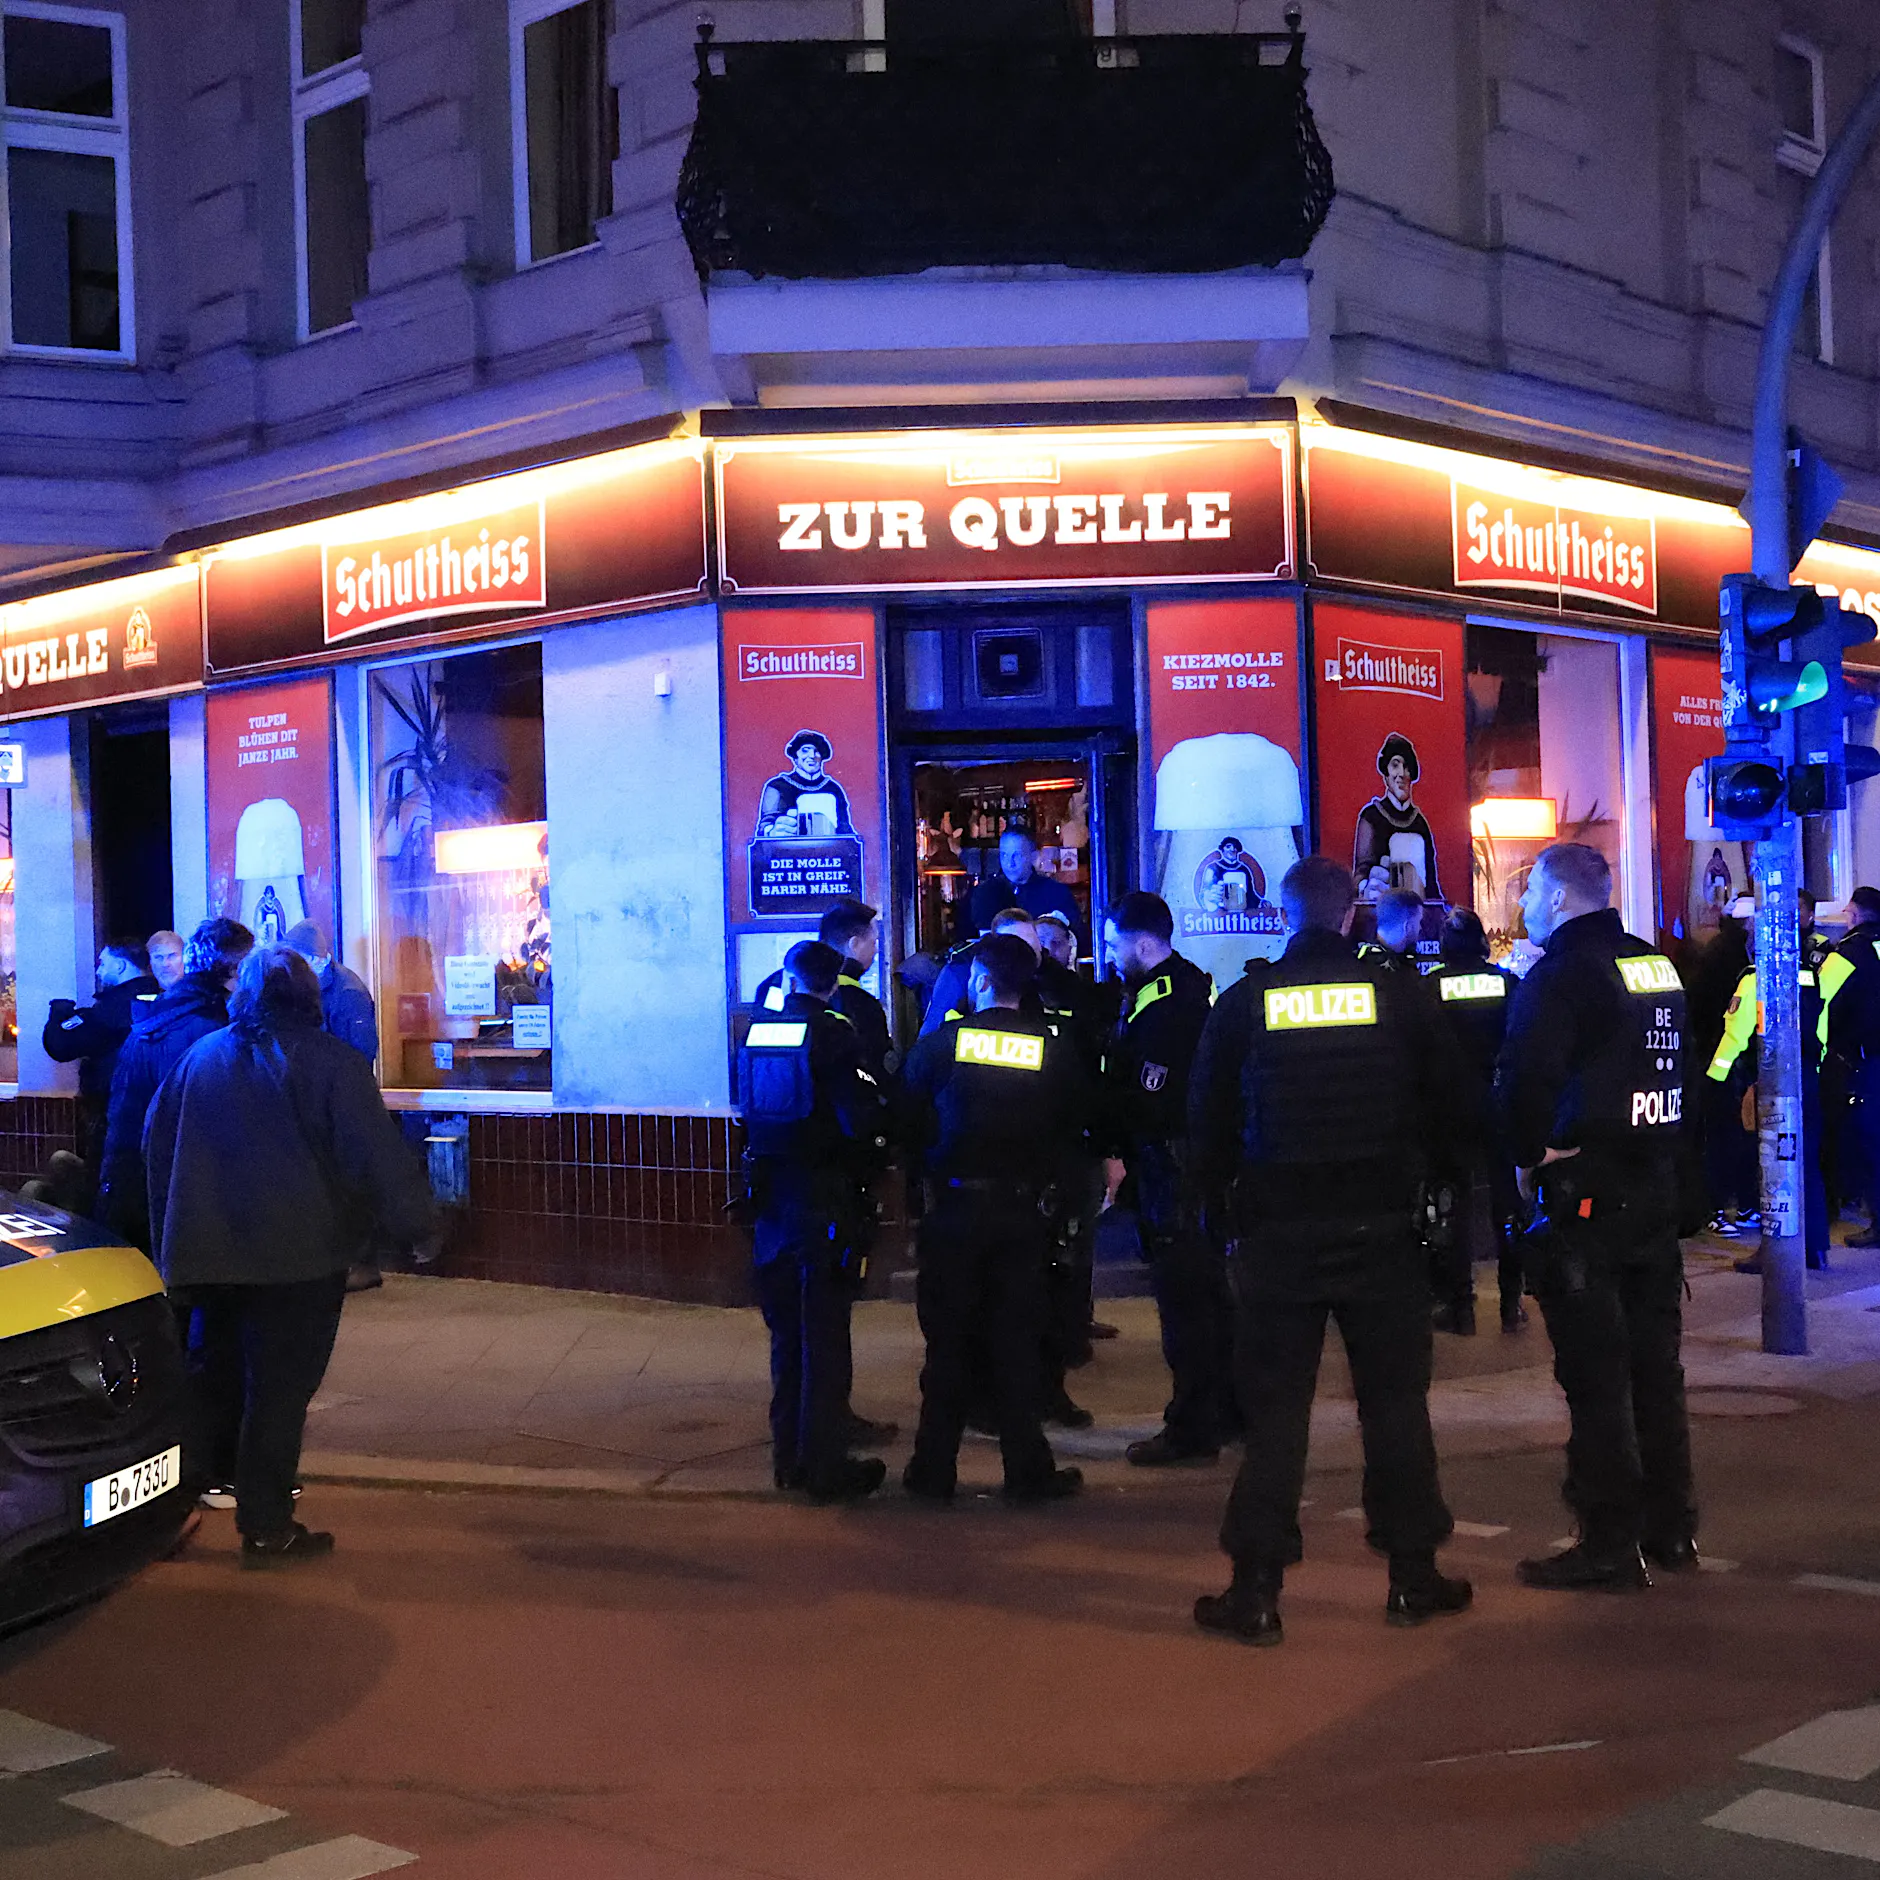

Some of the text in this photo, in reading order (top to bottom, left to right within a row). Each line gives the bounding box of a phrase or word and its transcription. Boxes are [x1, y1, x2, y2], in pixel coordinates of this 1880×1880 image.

[777, 492, 1231, 551] ZUR QUELLE
[1466, 501, 1645, 589] Schultheiss
[335, 527, 530, 617] Schultheiss
[0, 627, 109, 695] UELLE
[746, 649, 857, 673] Schultheiss
[1163, 651, 1284, 670] KIEZMOLLE
[1344, 648, 1437, 688] Schultheiss
[1171, 673, 1276, 690] SEIT 1842.
[1680, 695, 1708, 710] ALLES
[248, 712, 287, 730] TULPEN
[1672, 711, 1692, 725] VON
[1693, 713, 1712, 727] DER
[238, 728, 298, 748] BLÜHEN DIT
[238, 746, 299, 768] JANZE JAHR.
[770, 858, 841, 869] DIE MOLLE
[762, 872, 785, 882] IST
[787, 871, 802, 882] IN
[761, 882, 852, 896] BARER NÄHE.
[1183, 912, 1282, 933] Schultheiss
[1441, 975, 1505, 1001] POLIZEI
[1268, 987, 1372, 1025] POLIZEI
[1655, 1007, 1672, 1028] BE
[959, 1032, 1041, 1066] POLIZEI
[1645, 1029, 1680, 1050] 12110
[1631, 1086, 1683, 1126] POLIZE
[109, 1454, 169, 1511] B 7330
